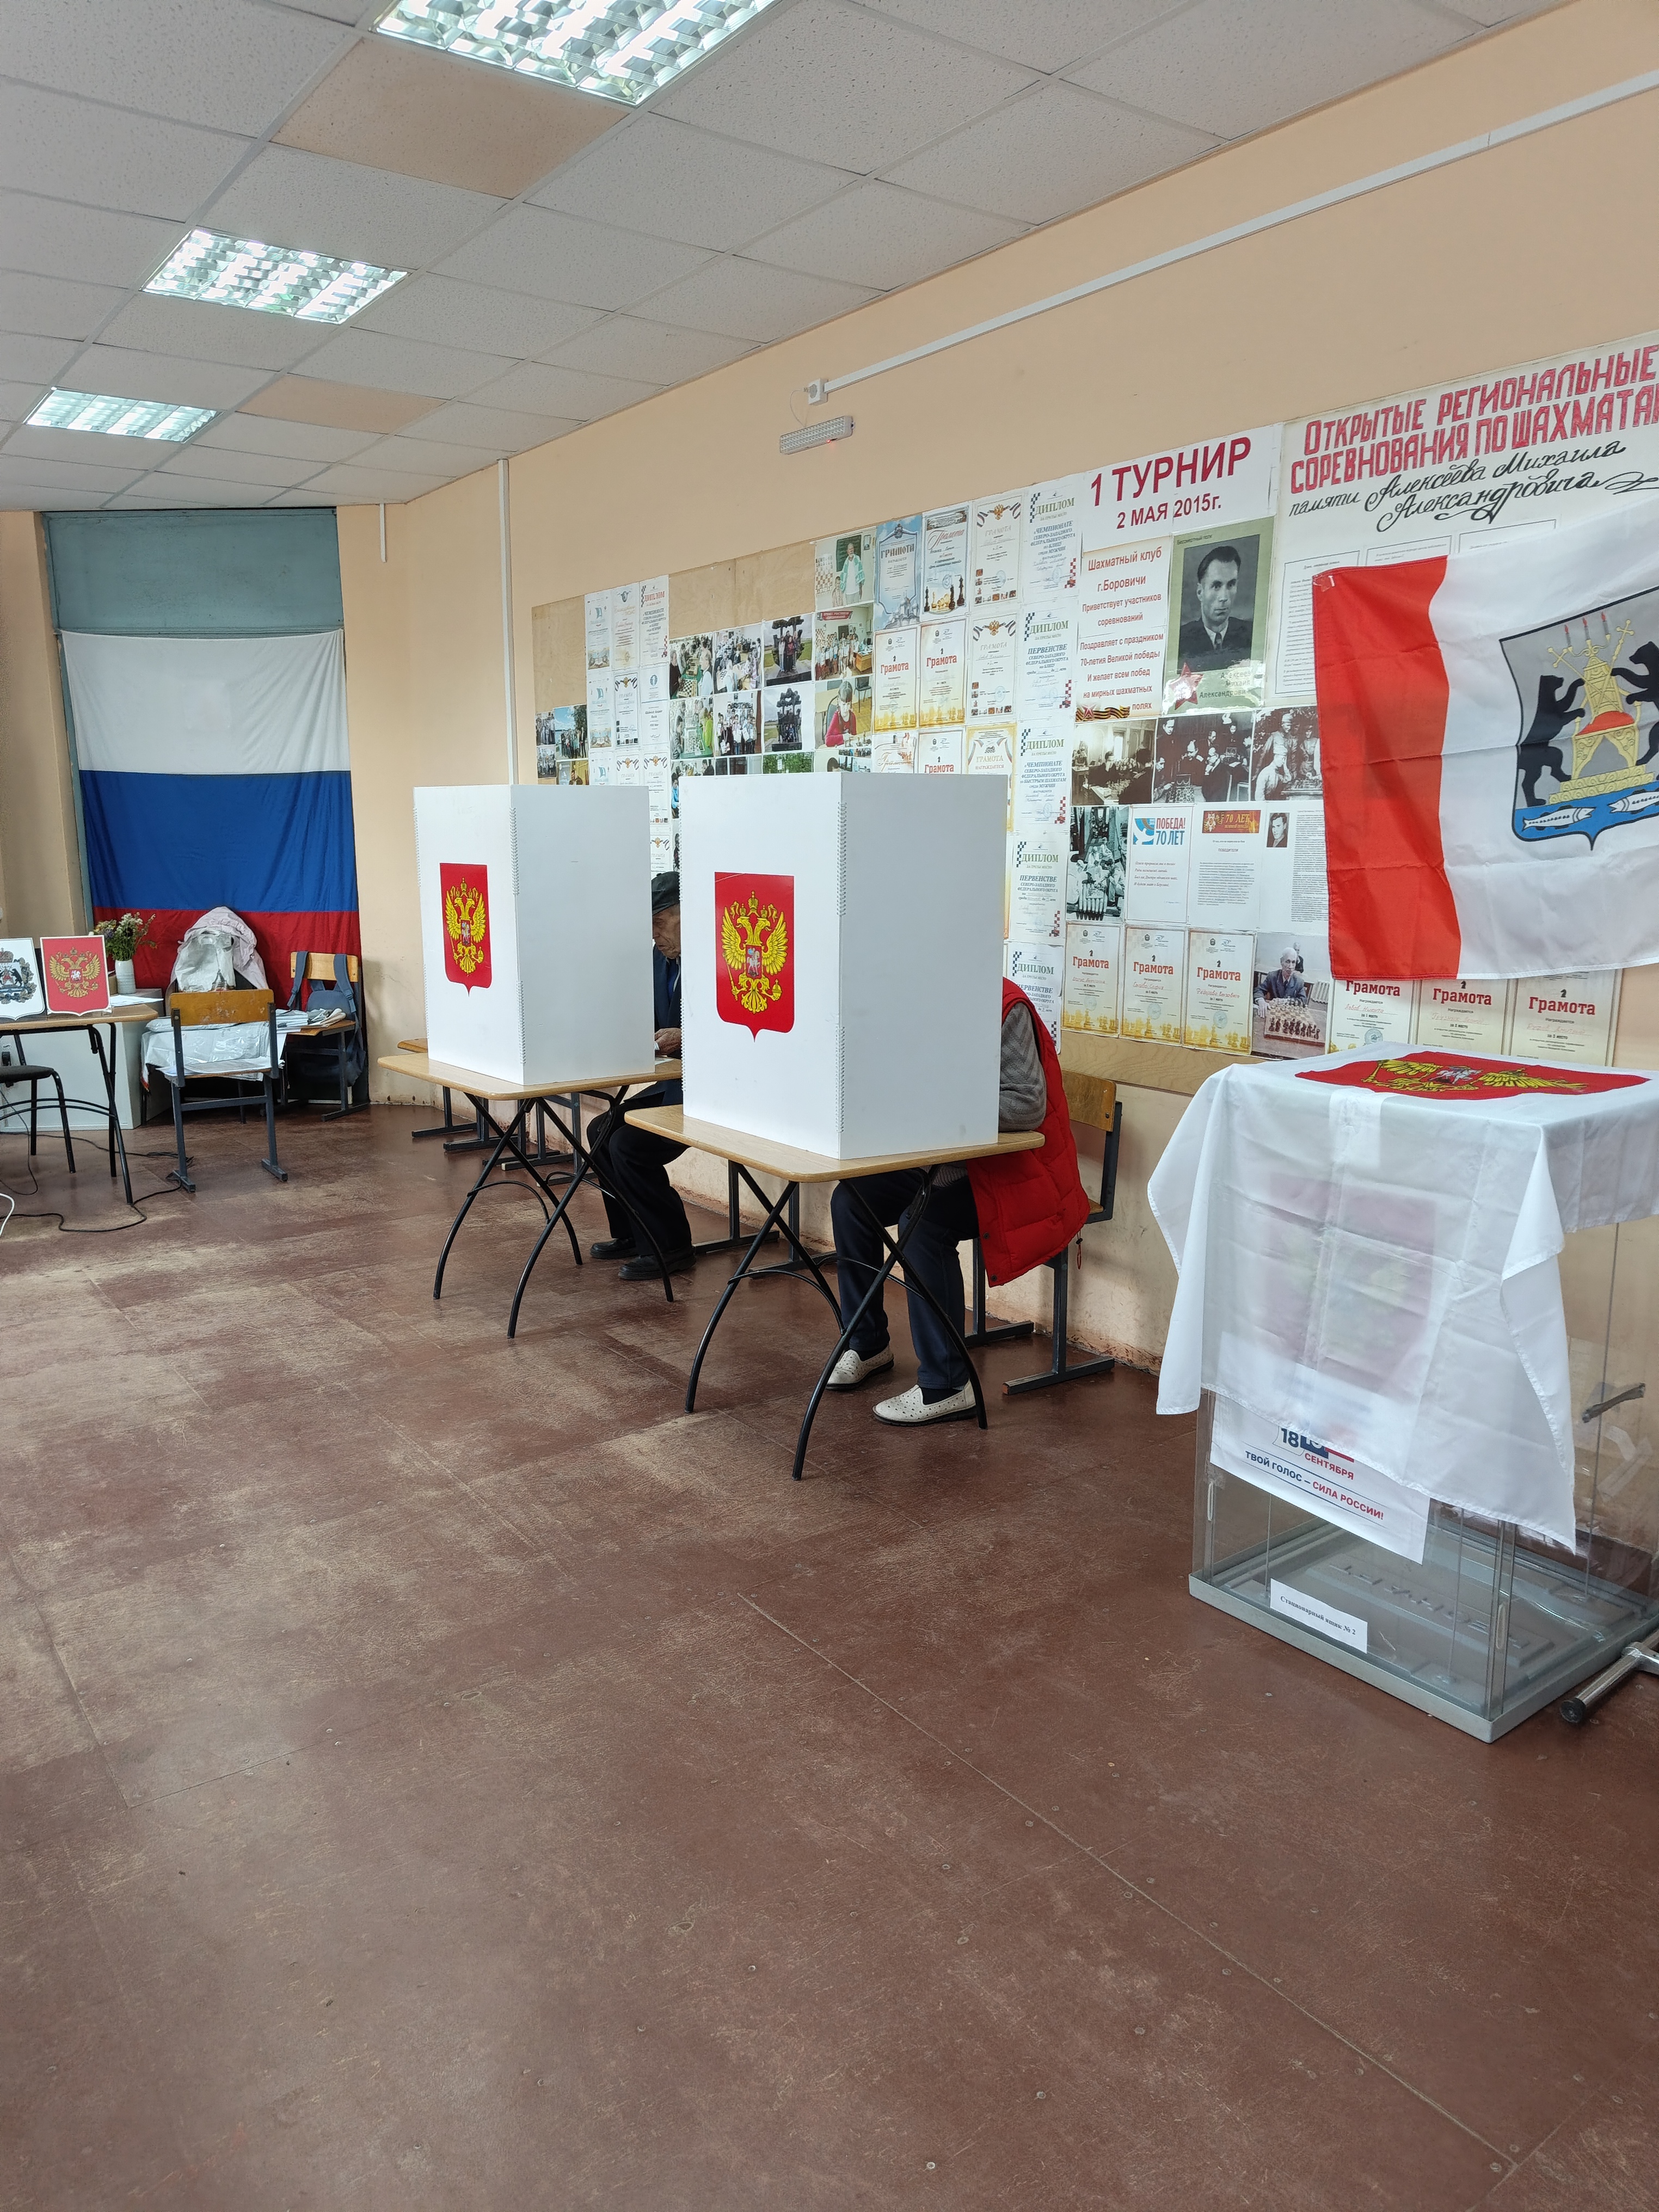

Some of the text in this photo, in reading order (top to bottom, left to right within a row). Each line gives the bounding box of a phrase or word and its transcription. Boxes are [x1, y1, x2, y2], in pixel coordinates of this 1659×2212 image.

[1304, 345, 1659, 456] ОТКРЫТЫЕ РЕГИОНАЛЬНЫЕ
[1291, 422, 1470, 494] СОРЕВНОВАНИЯ
[1474, 415, 1509, 456] ПО
[1091, 437, 1251, 507] 1 ТУРНИР
[1289, 440, 1626, 517] памяти Алексеева Михаила
[1035, 497, 1075, 516] ДИПЛОМ
[1377, 469, 1600, 532] Александровича
[1117, 492, 1221, 529] 2 МАЯ 2015г.
[1088, 550, 1138, 571] Шахматный
[1140, 546, 1162, 562] клуб
[1097, 575, 1146, 592] г.Боровичи
[1082, 593, 1162, 613] Приветствует участников
[1029, 620, 1069, 635] ДИПЛОМ
[1098, 612, 1144, 627] соревнований
[1028, 643, 1068, 654] ПЕРВЕНСТВЕ
[1080, 638, 1118, 650] Поздравляет
[1124, 633, 1164, 646] праздником
[926, 655, 957, 668] Грамота
[1080, 650, 1160, 666] 70-летия Великой победы
[880, 662, 909, 675] Грамота
[1087, 674, 1092, 682] И
[1130, 667, 1151, 677] побед
[1091, 689, 1115, 699] мирных
[1116, 685, 1153, 695] шахматных
[1132, 702, 1152, 710] полях
[1026, 739, 1065, 751] ДИПЛОМ
[925, 764, 954, 774] Грамота
[1156, 817, 1186, 830] ПОБЕДА!
[1225, 813, 1250, 823] 70 ЛЕТ
[1156, 830, 1185, 845] 70 ЛЕТ
[1021, 853, 1059, 863] ДИПЛОМ
[1017, 963, 1055, 975] ДИПЛОМ
[1072, 956, 1109, 969] Грамота
[1133, 961, 1174, 975] Грамота
[1197, 967, 1241, 981] Грамота
[1346, 980, 1400, 997] Грамота
[1433, 988, 1492, 1005] Грамота
[1528, 997, 1596, 1015] Грамота
[1281, 1427, 1299, 1448] 18
[1304, 1452, 1354, 1480] СЕНТЯБРЯ
[1245, 1450, 1270, 1467] ТВОЙ
[1272, 1462, 1302, 1482] ГОЛОС
[1312, 1480, 1338, 1500] СИЛА
[1340, 1494, 1385, 1520] РОССИИ!
[1280, 1595, 1325, 1621] Стационарный
[1325, 1618, 1343, 1630] ящик
[1343, 1624, 1351, 1633] №
